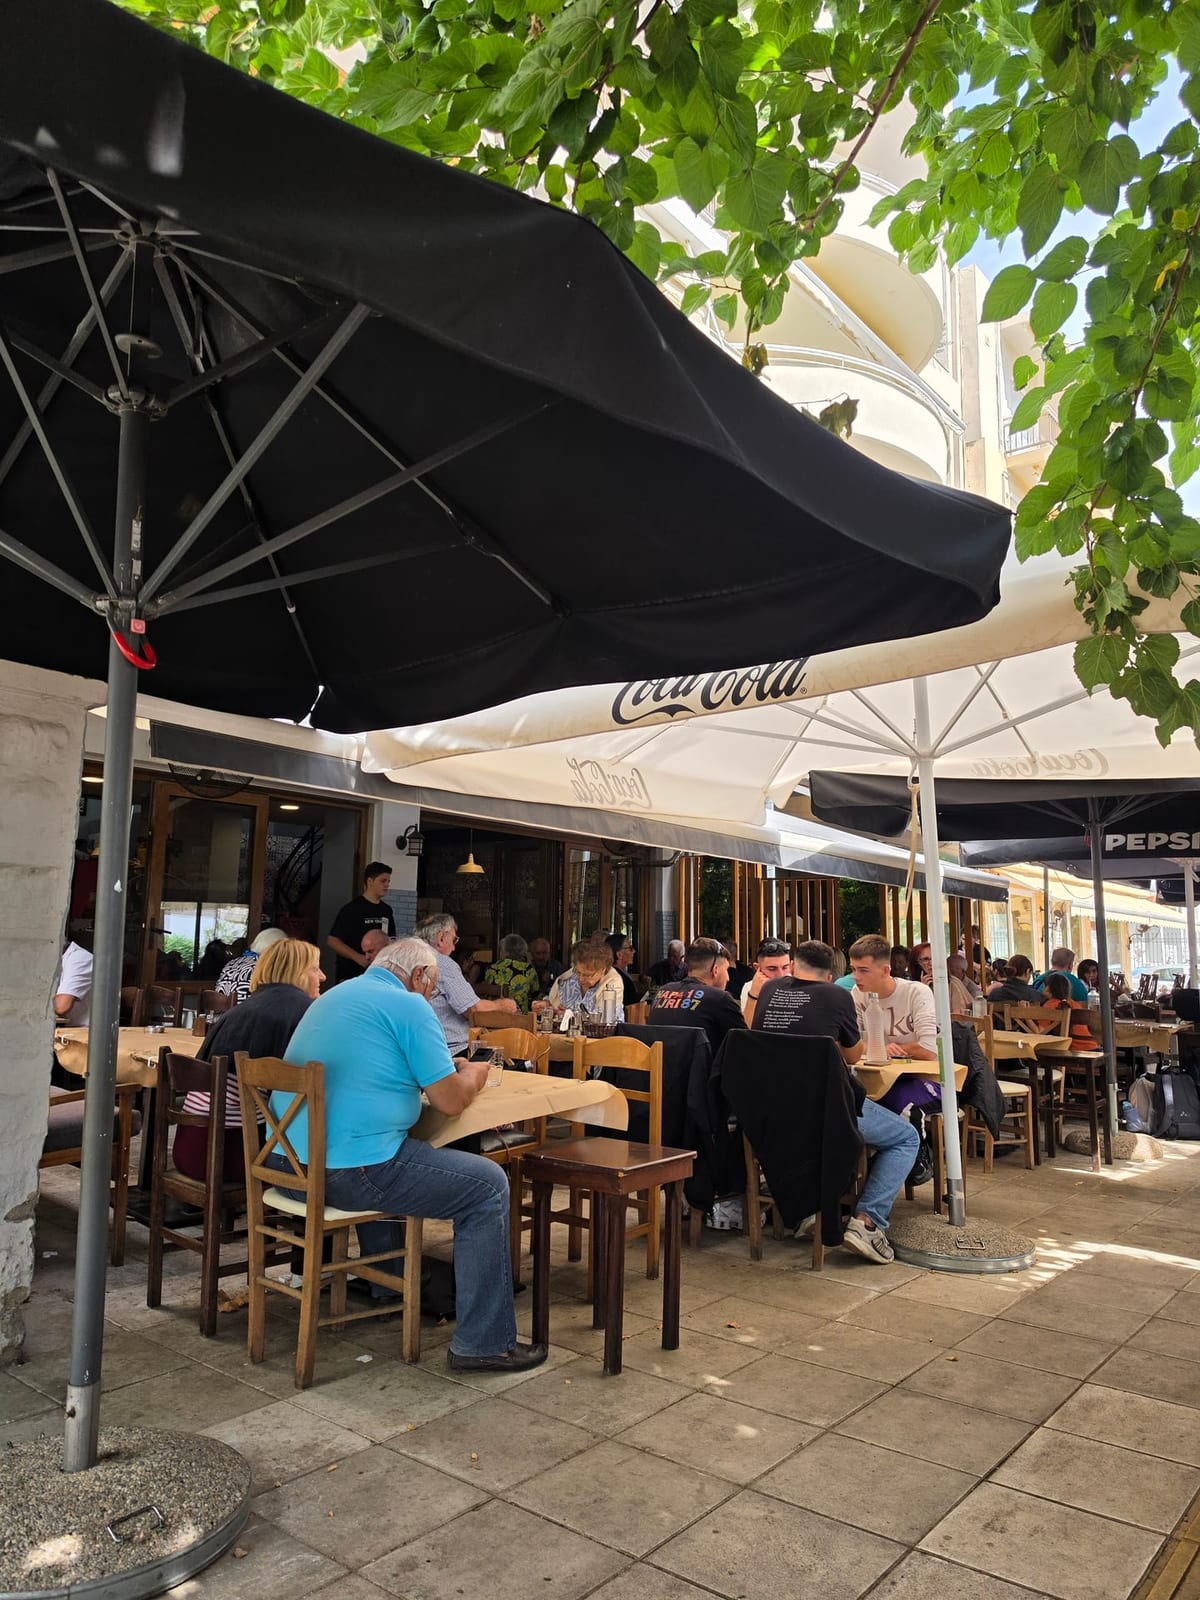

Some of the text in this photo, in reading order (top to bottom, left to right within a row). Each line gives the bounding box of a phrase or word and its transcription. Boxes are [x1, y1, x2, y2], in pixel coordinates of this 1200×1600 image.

[611, 657, 809, 725] CocaCola
[1105, 832, 1200, 851] PEPSI
[680, 998, 702, 1011] 87
